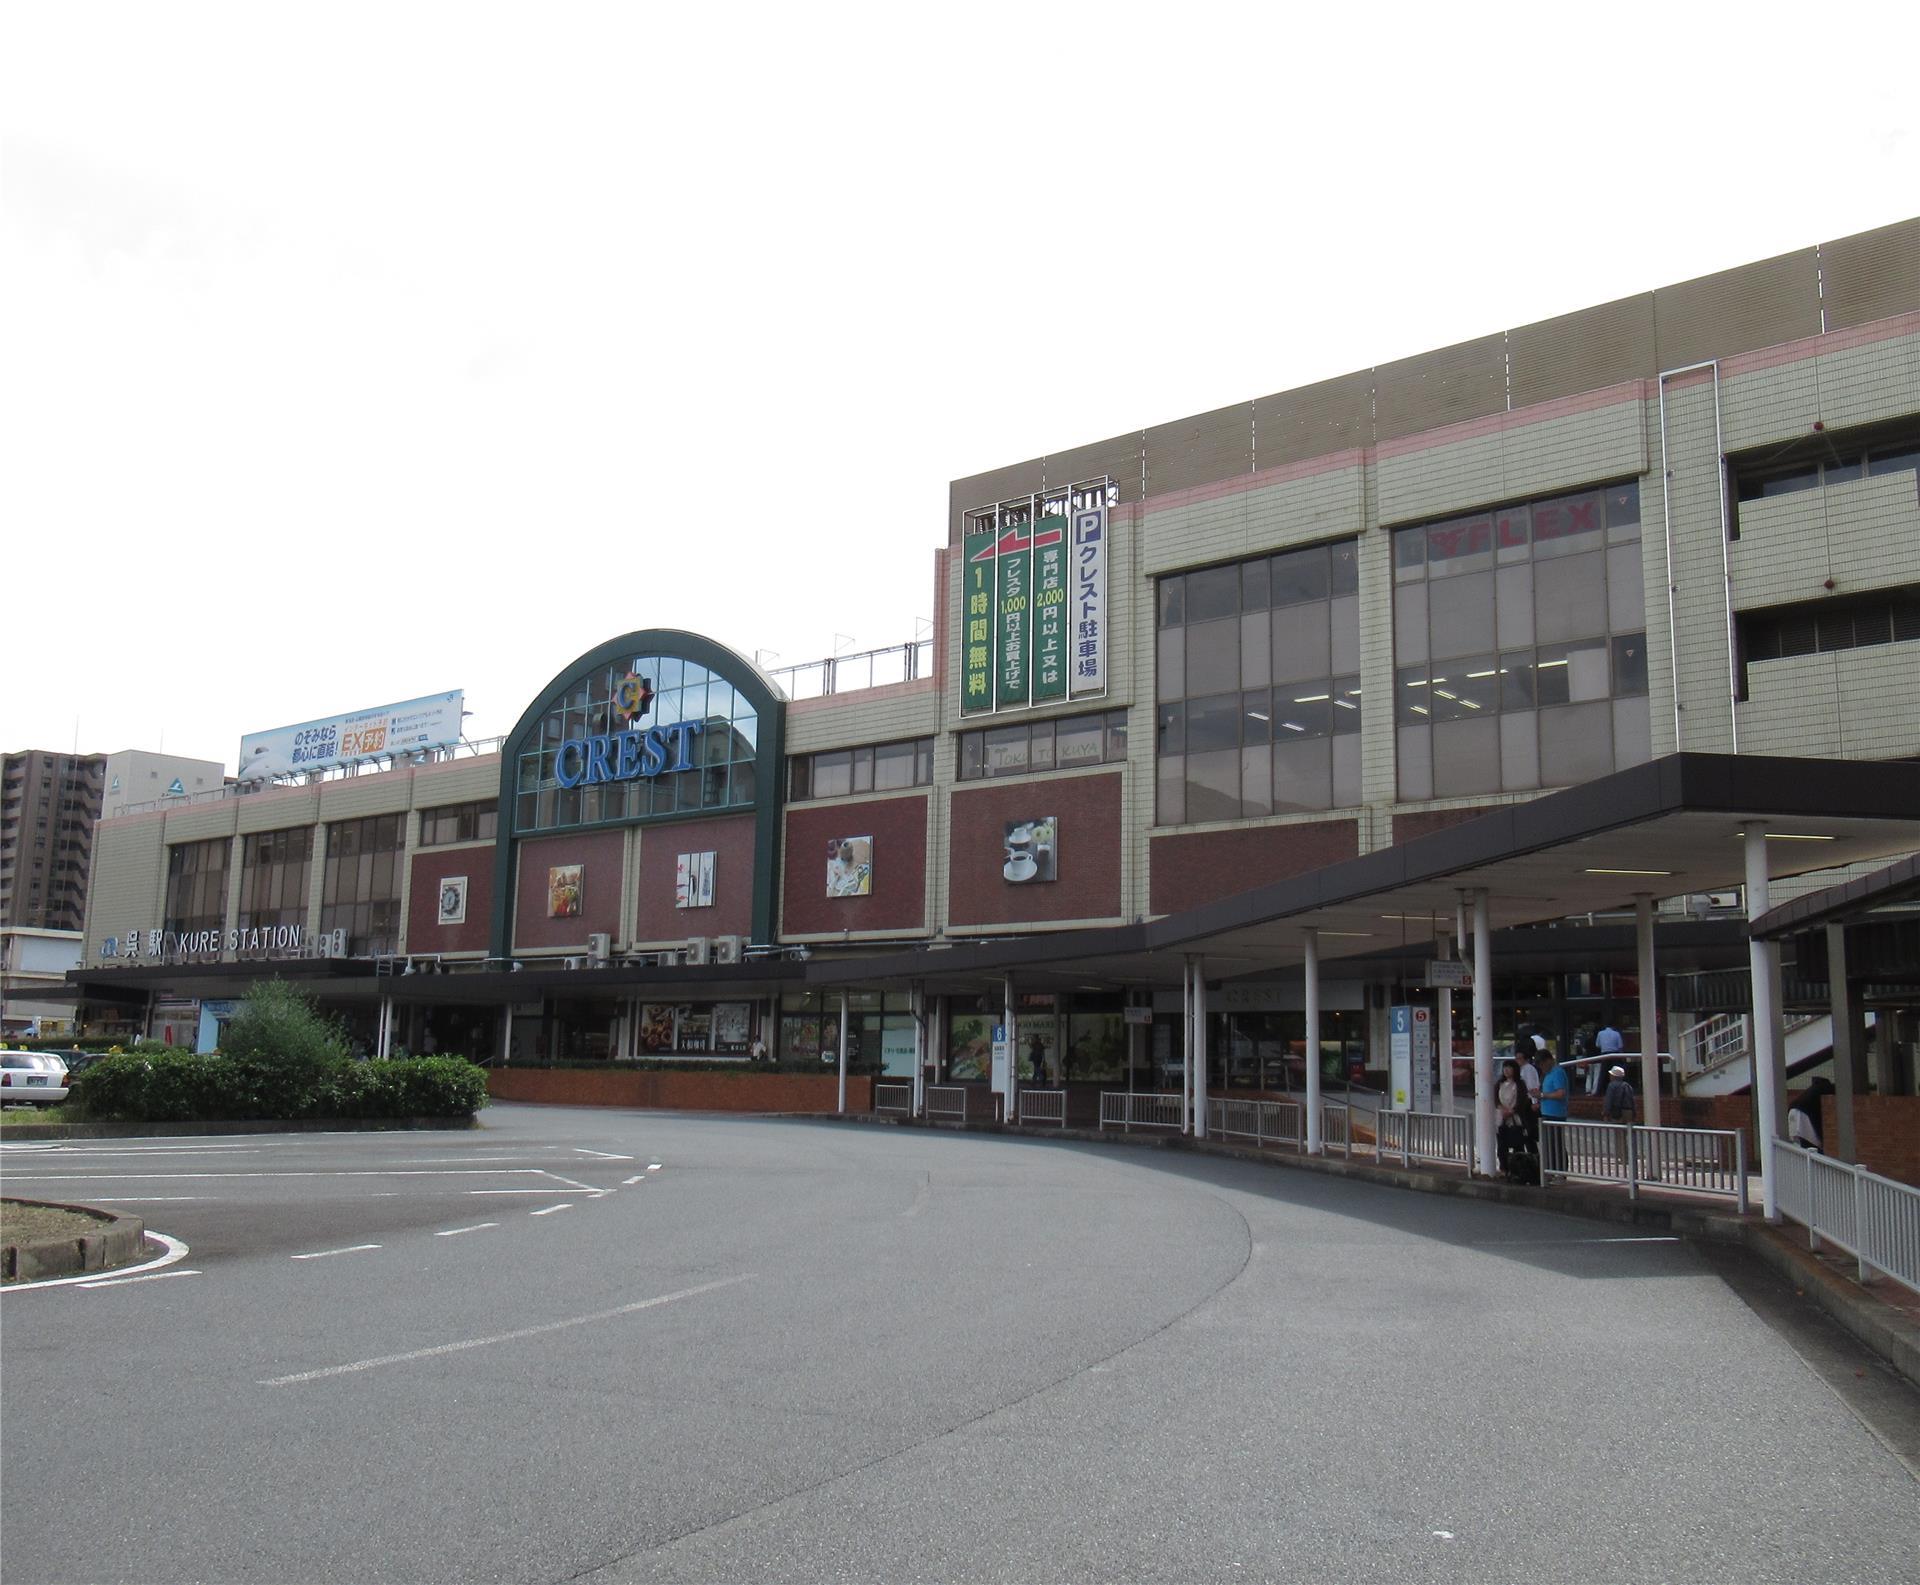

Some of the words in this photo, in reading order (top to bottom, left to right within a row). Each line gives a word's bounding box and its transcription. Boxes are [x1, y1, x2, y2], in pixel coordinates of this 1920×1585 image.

[1079, 516, 1098, 542] P
[1078, 546, 1098, 677] クレスト駐車場
[968, 567, 988, 696] 1時間無料
[294, 725, 337, 744] のぞみなら
[555, 719, 702, 789] CREST
[125, 929, 163, 958] 呉駅
[179, 930, 220, 953] KURE
[229, 925, 300, 951] STATION
[996, 1027, 1002, 1040] 6
[1396, 1010, 1403, 1032] 5
